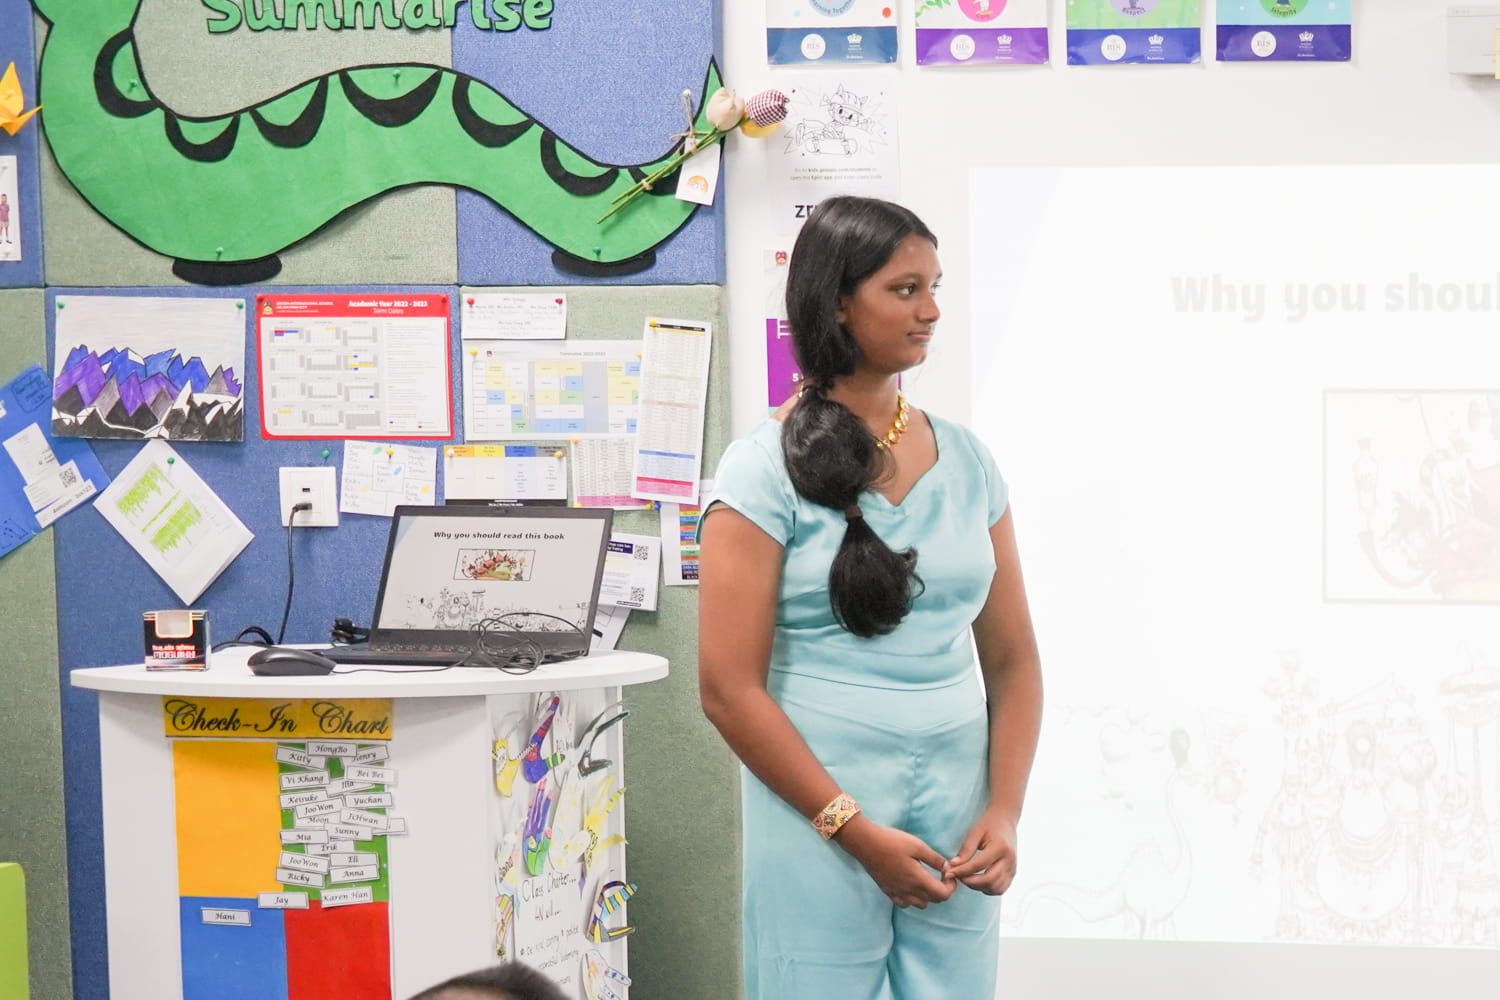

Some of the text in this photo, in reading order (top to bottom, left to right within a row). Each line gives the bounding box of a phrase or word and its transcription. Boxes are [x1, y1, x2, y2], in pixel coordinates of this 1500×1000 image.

[205, 0, 555, 32] Summarise
[1170, 273, 1266, 323] Why
[1283, 281, 1367, 323] you
[434, 531, 452, 539] Why
[473, 531, 501, 539] should
[543, 532, 565, 540] book
[164, 699, 389, 734] Check-In Chart
[288, 753, 312, 764] Kitty
[297, 775, 324, 784] Khang
[288, 794, 319, 804] Keisuke
[335, 827, 360, 836] Sunny
[321, 843, 338, 852] Erik
[288, 873, 310, 883] Ricky
[274, 896, 289, 904] Jay
[323, 893, 349, 902] Karen
[215, 912, 236, 921] Hani
